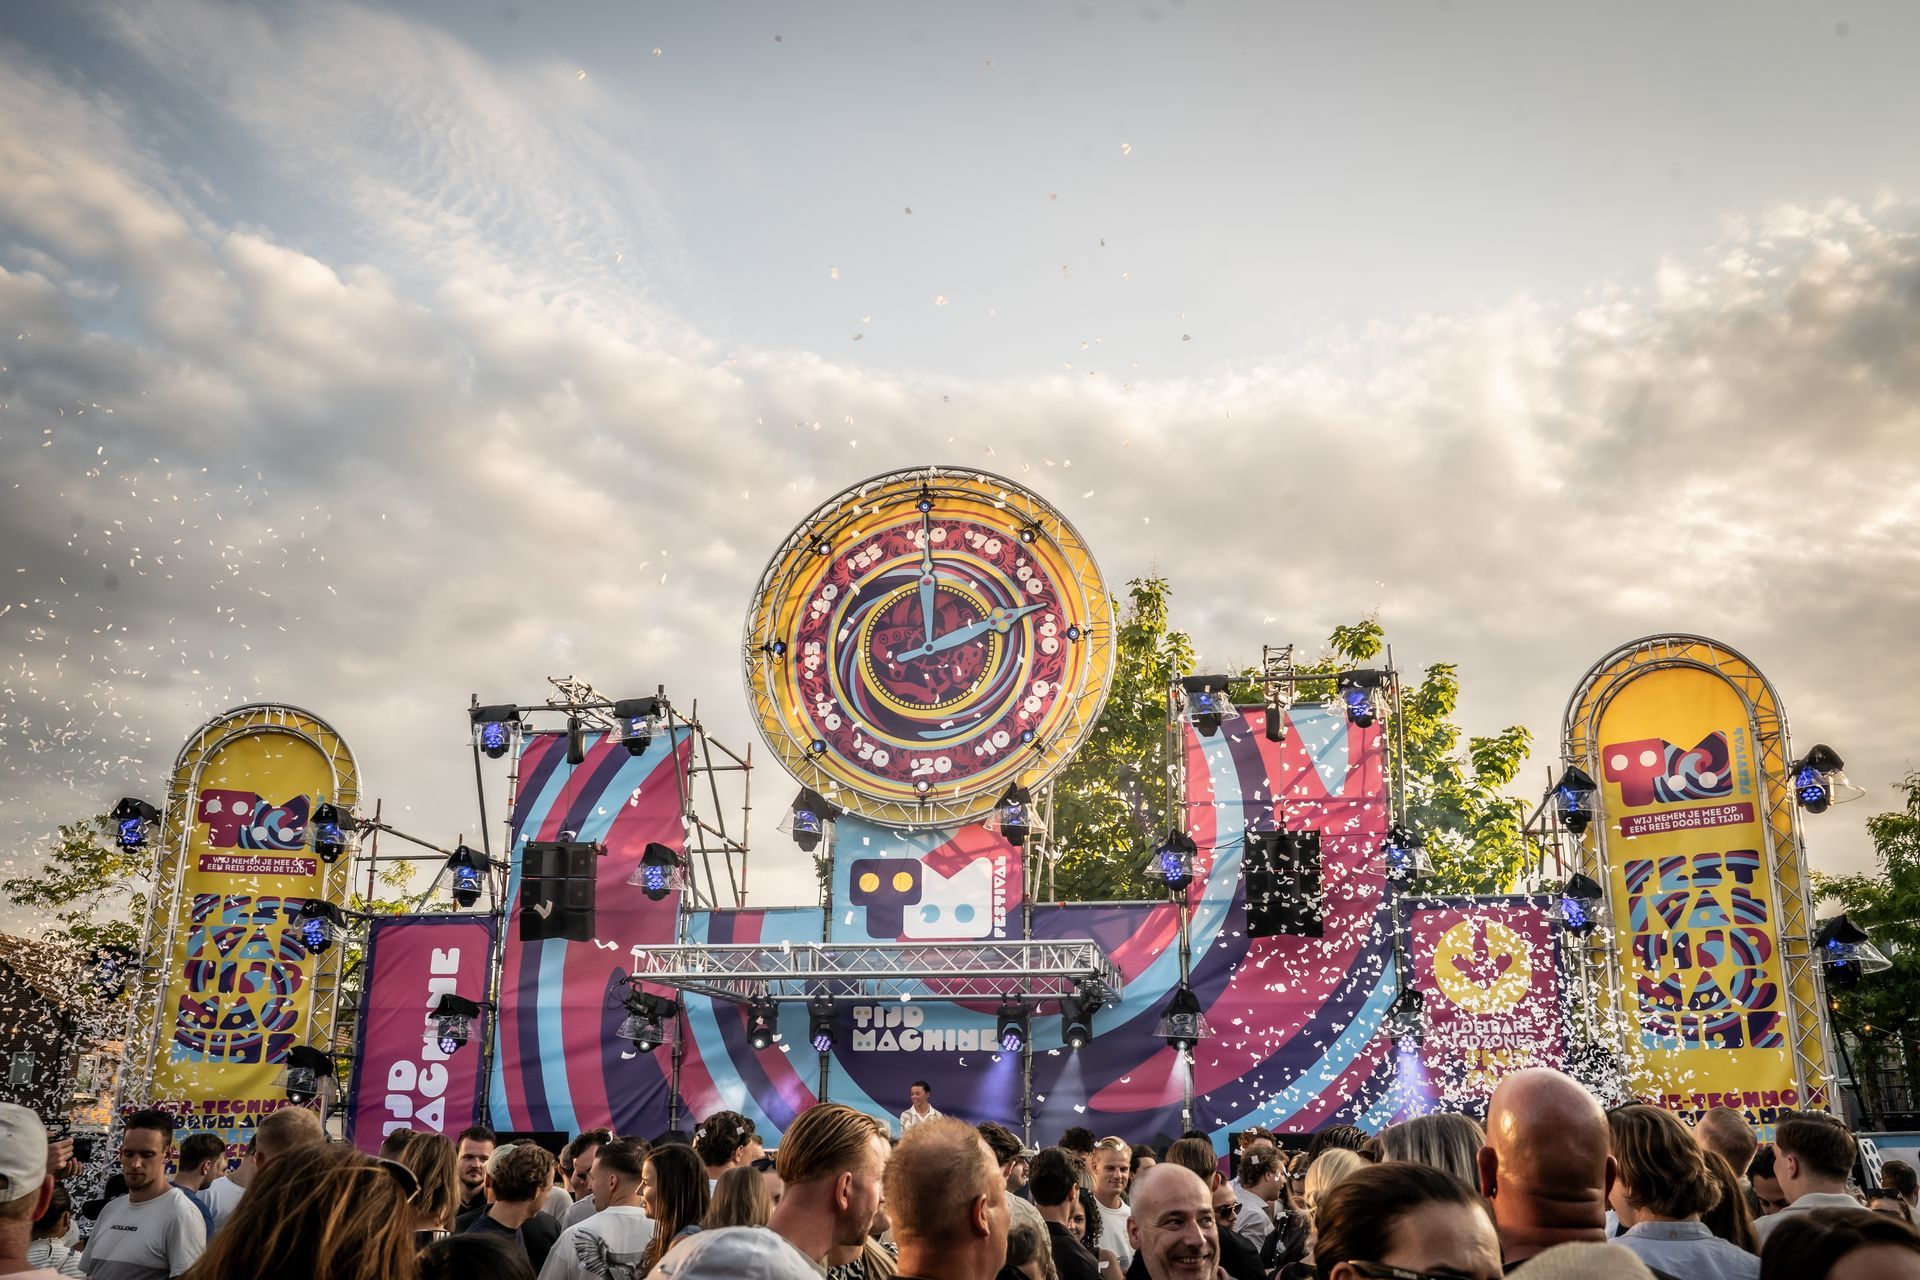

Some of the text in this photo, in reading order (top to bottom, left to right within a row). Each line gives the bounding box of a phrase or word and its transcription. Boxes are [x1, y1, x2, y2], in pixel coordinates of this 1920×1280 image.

[1733, 727, 1751, 797] FESTIVAL
[1629, 813, 1744, 834] EEN REIS DOOR DE TIJD!
[1633, 805, 1737, 825] WIJ NEMEN JE MEE OP
[207, 863, 225, 871] EEN
[225, 864, 245, 872] REIS
[246, 865, 272, 873] DOOR
[272, 865, 285, 873] DE
[232, 857, 260, 866] NEMEN
[261, 858, 272, 866] JE
[273, 858, 291, 866] MEE
[1624, 849, 1760, 894] FEST
[993, 855, 1007, 938] FESTIVAL
[1632, 927, 1772, 972] TIJD
[183, 959, 304, 996] TIJD
[853, 1006, 925, 1028] TIJD
[852, 1028, 999, 1052] MACHINE
[382, 1060, 418, 1143] IJD
